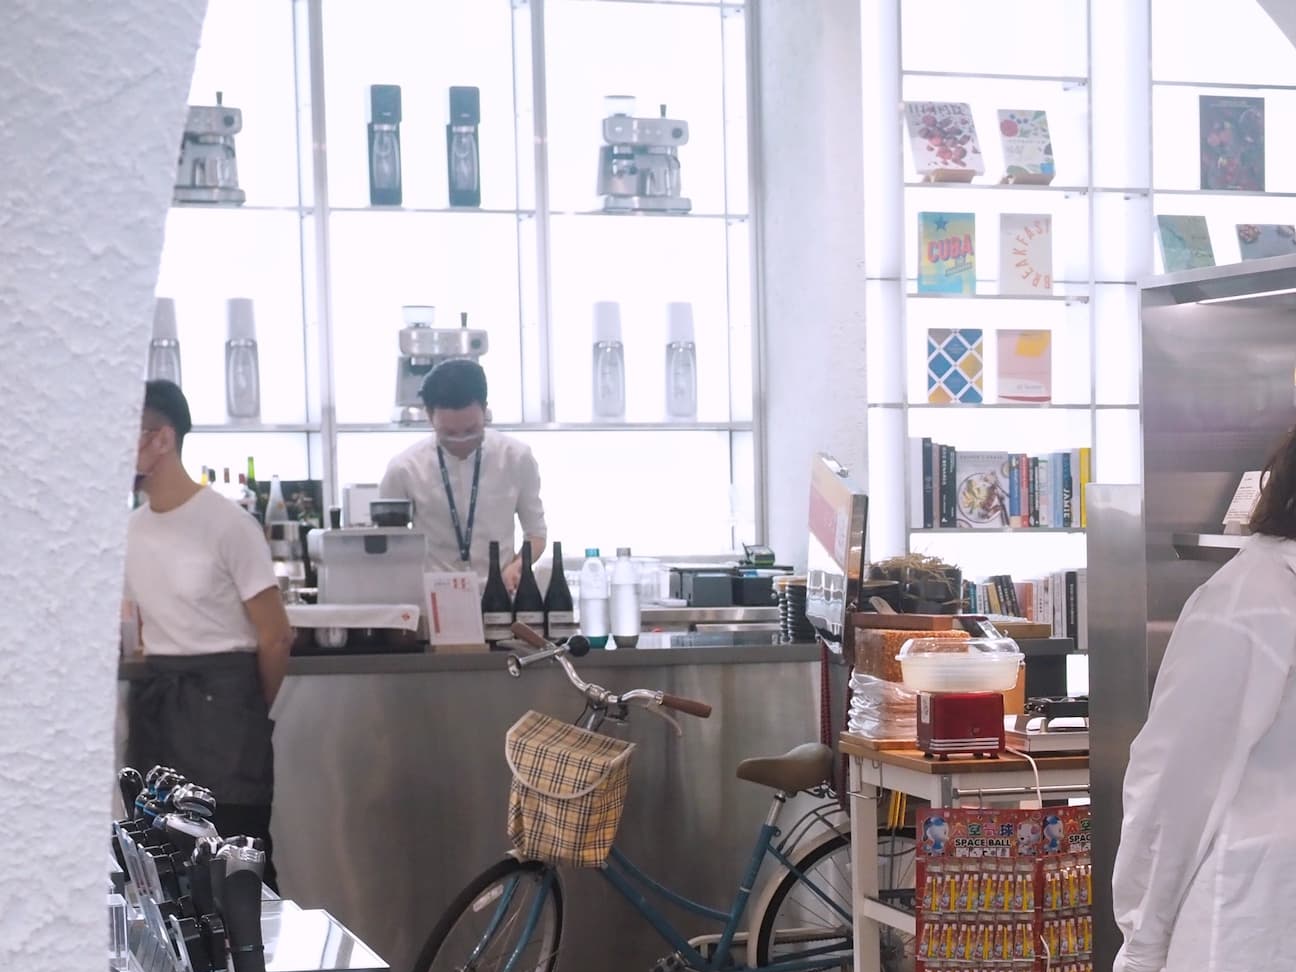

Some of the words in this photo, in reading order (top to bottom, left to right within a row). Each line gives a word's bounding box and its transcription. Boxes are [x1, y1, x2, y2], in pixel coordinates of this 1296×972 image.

[927, 233, 974, 263] CUBA
[1063, 488, 1071, 518] JAMIE
[955, 838, 985, 847] SPACE
[988, 838, 1011, 847] BALL
